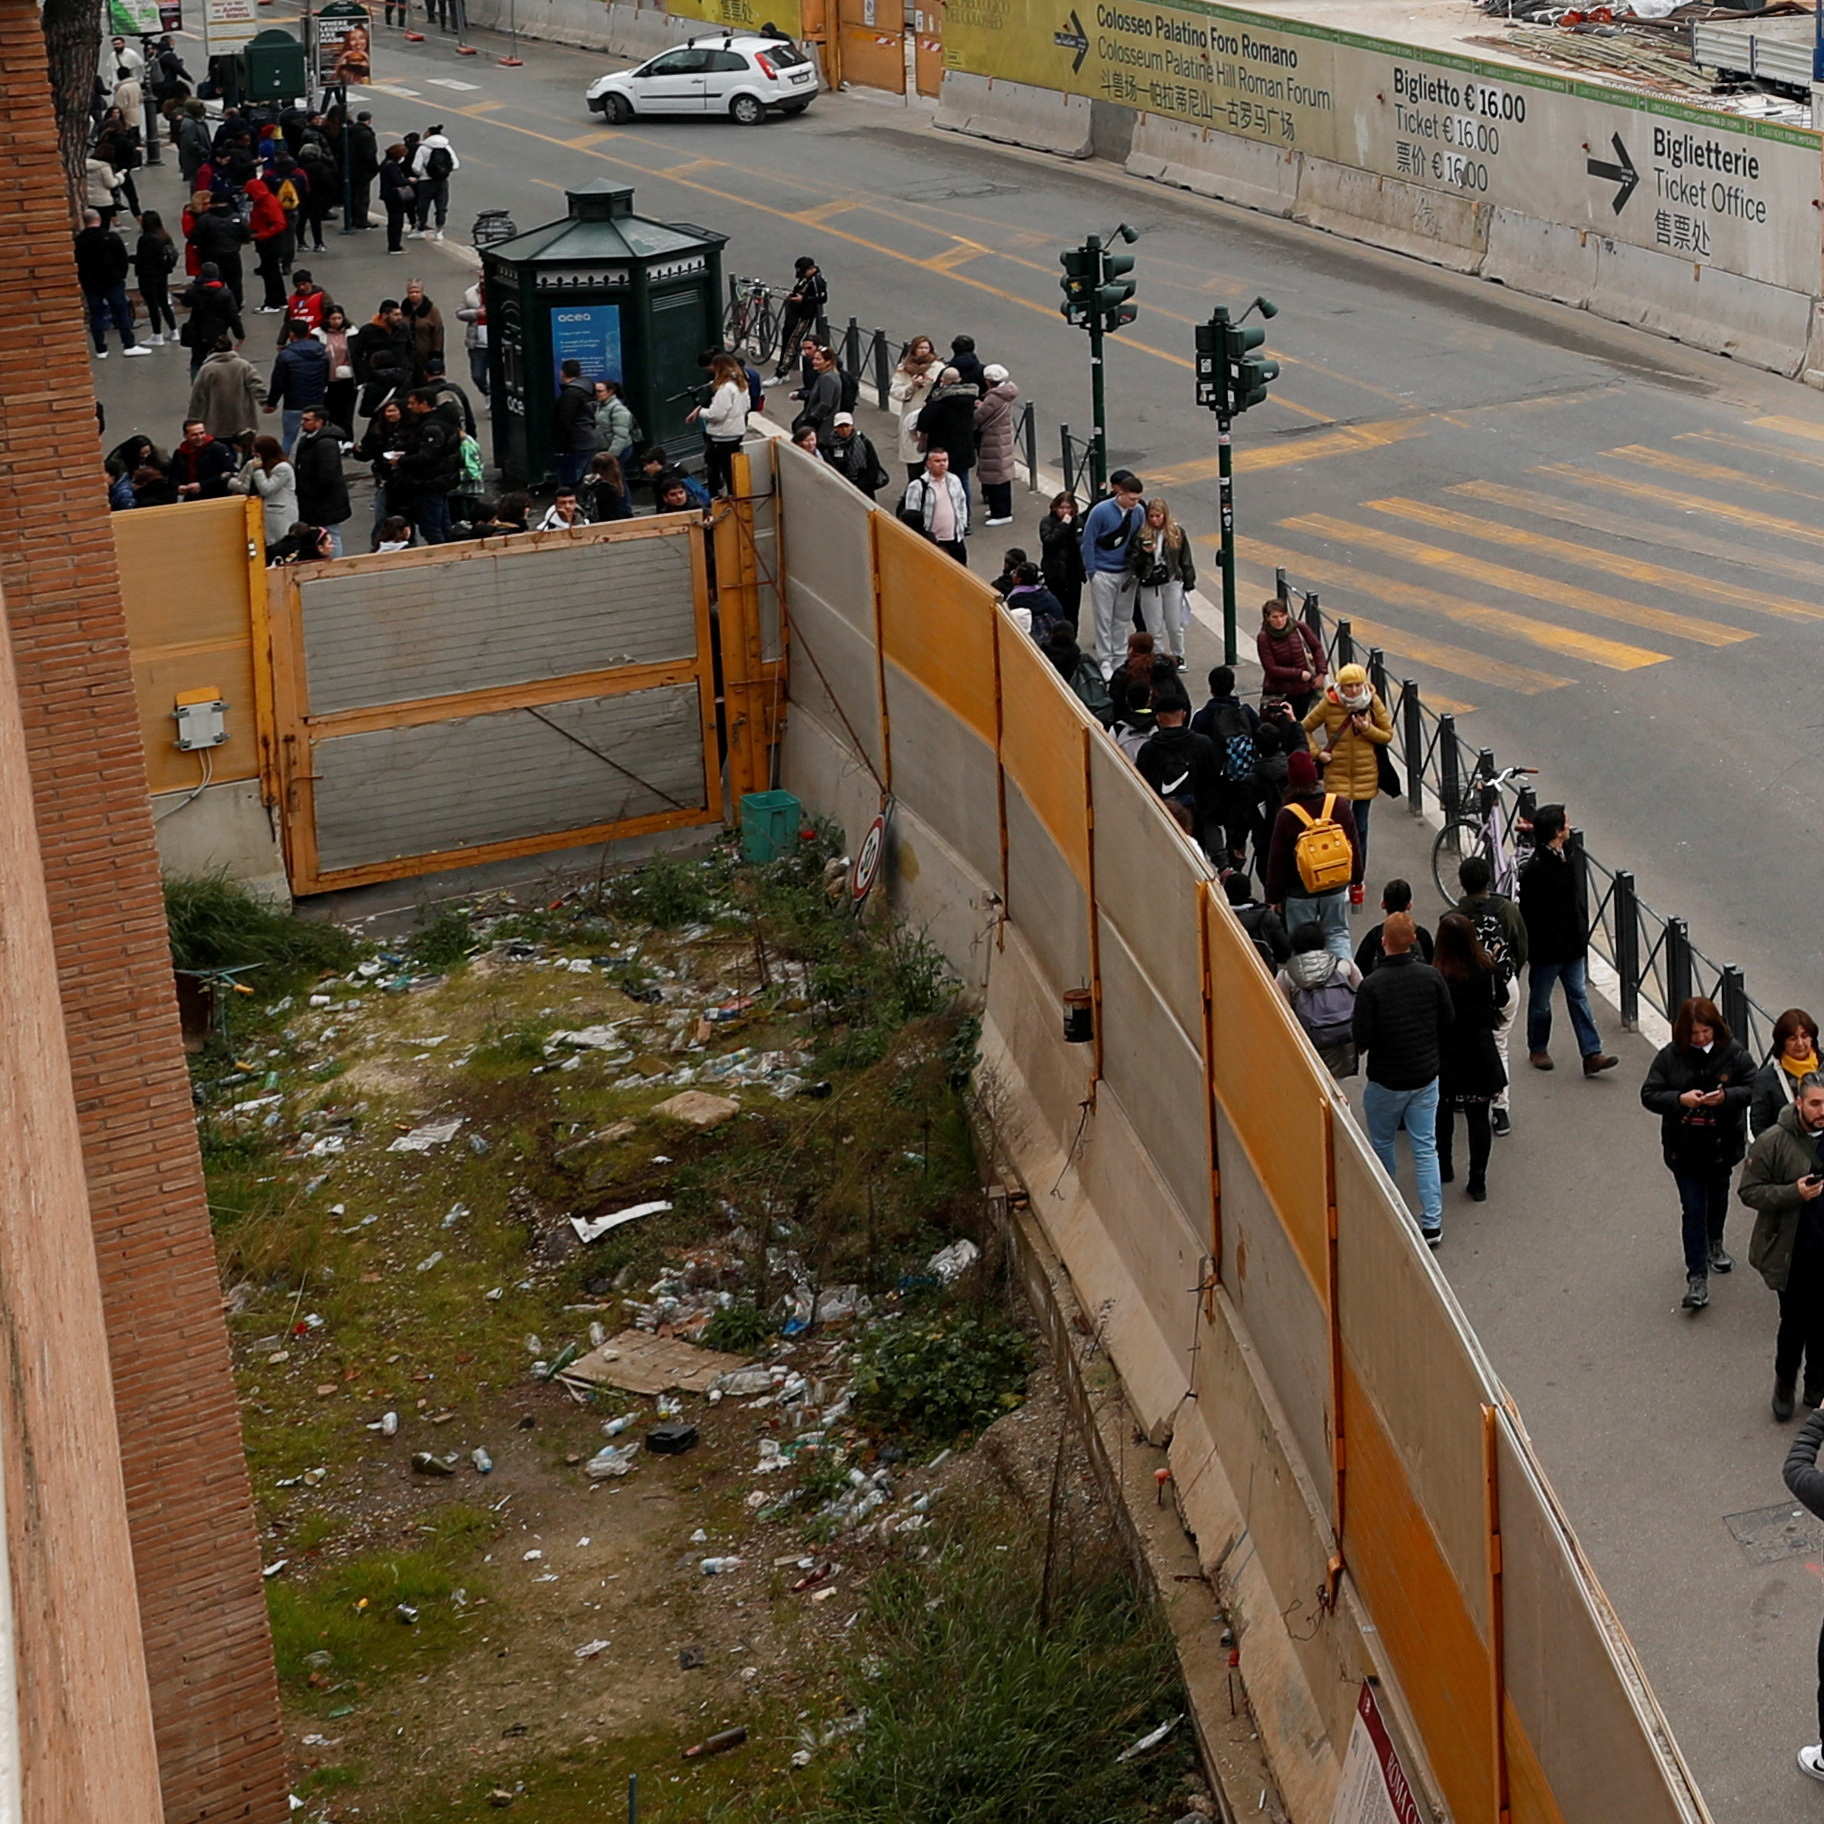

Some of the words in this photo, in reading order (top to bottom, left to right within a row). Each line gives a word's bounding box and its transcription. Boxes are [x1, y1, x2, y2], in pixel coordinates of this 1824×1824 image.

[1097, 4, 1152, 36] Colosseo
[1156, 16, 1207, 49] Palatino
[1210, 27, 1238, 55] Foro
[1242, 34, 1298, 68] Romano
[1099, 36, 1163, 71] Colosseum
[1166, 50, 1214, 83] Palatine
[1216, 61, 1235, 89] Hill
[1239, 67, 1283, 100] Roman
[1287, 78, 1330, 110] Forum
[1394, 67, 1459, 107] Biglietto
[1464, 84, 1475, 111] €
[1479, 88, 1525, 123] 16.00
[1395, 103, 1439, 140] Ticket
[1442, 116, 1453, 142] €
[1457, 121, 1499, 155] 16.00
[1654, 127, 1759, 179] Biglietterie
[1396, 140, 1426, 177] 票价
[1432, 152, 1442, 179] €
[1654, 167, 1706, 209] Ticket
[1712, 182, 1766, 223] Office
[1654, 208, 1710, 257] 售票处
[558, 313, 591, 322] acea
[1387, 1752, 1406, 1814] ROMA
